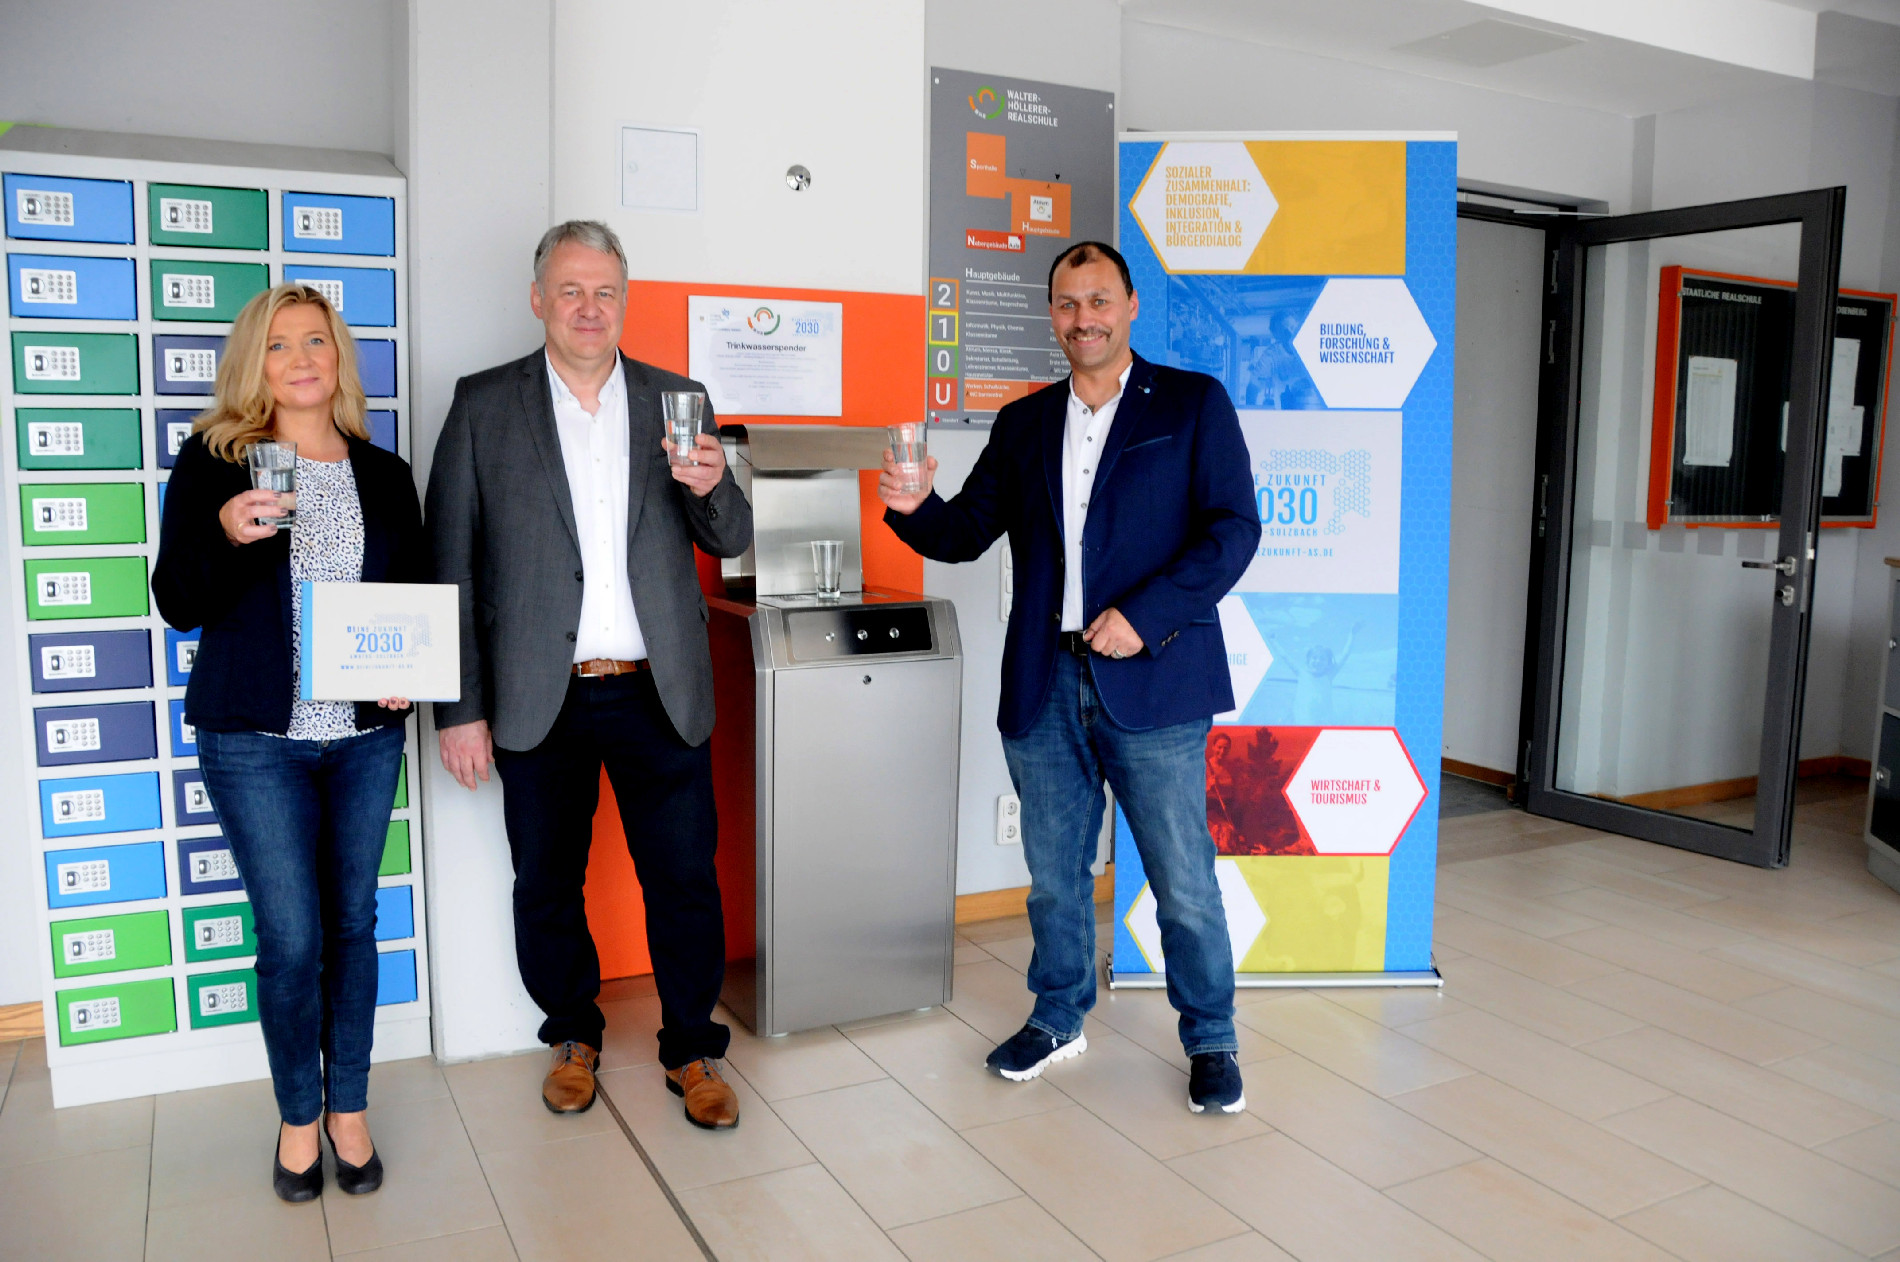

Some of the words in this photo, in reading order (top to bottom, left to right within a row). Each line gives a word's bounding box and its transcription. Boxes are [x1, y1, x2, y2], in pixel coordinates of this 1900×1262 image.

[1007, 89, 1041, 102] WALTER-
[1008, 100, 1051, 114] HÖLLERER-
[1008, 112, 1058, 127] REALSCHULE
[1166, 166, 1212, 178] SOZIALER
[1166, 180, 1250, 192] ZUSAMMENHALT:
[1166, 193, 1232, 208] DEMOGRAFIE,
[1166, 207, 1222, 222] INKLUSION,
[1166, 221, 1231, 233] INTEGRATION
[1235, 220, 1242, 233] &
[1166, 231, 1242, 247] BÜRGERDIALOG
[966, 268, 1020, 282] Hauptgebäude
[938, 284, 951, 306] 2
[1682, 287, 1720, 300] STAATLICHE
[1722, 292, 1762, 304] REALSCHULE
[1836, 306, 1868, 316] OSENBERG
[796, 320, 820, 334] 2030
[938, 317, 948, 339] 1
[1320, 323, 1366, 338] BILDUNG,
[726, 341, 806, 352] Trinkwasserspender
[1320, 338, 1380, 350] FORSCHUNG
[1382, 336, 1390, 350] &
[937, 350, 950, 372] 0
[1320, 351, 1394, 364] WISSENSCHAFT
[936, 382, 951, 406] U
[1267, 474, 1326, 486] ZUKUNFT
[1256, 487, 1318, 525] 030
[1256, 547, 1333, 557] EZUKUNFT-AS.DE
[355, 632, 403, 652] 2030
[1311, 779, 1370, 792] WIRTSCHAFT
[1374, 779, 1380, 792] &
[1310, 792, 1367, 804] TOURISMUS
